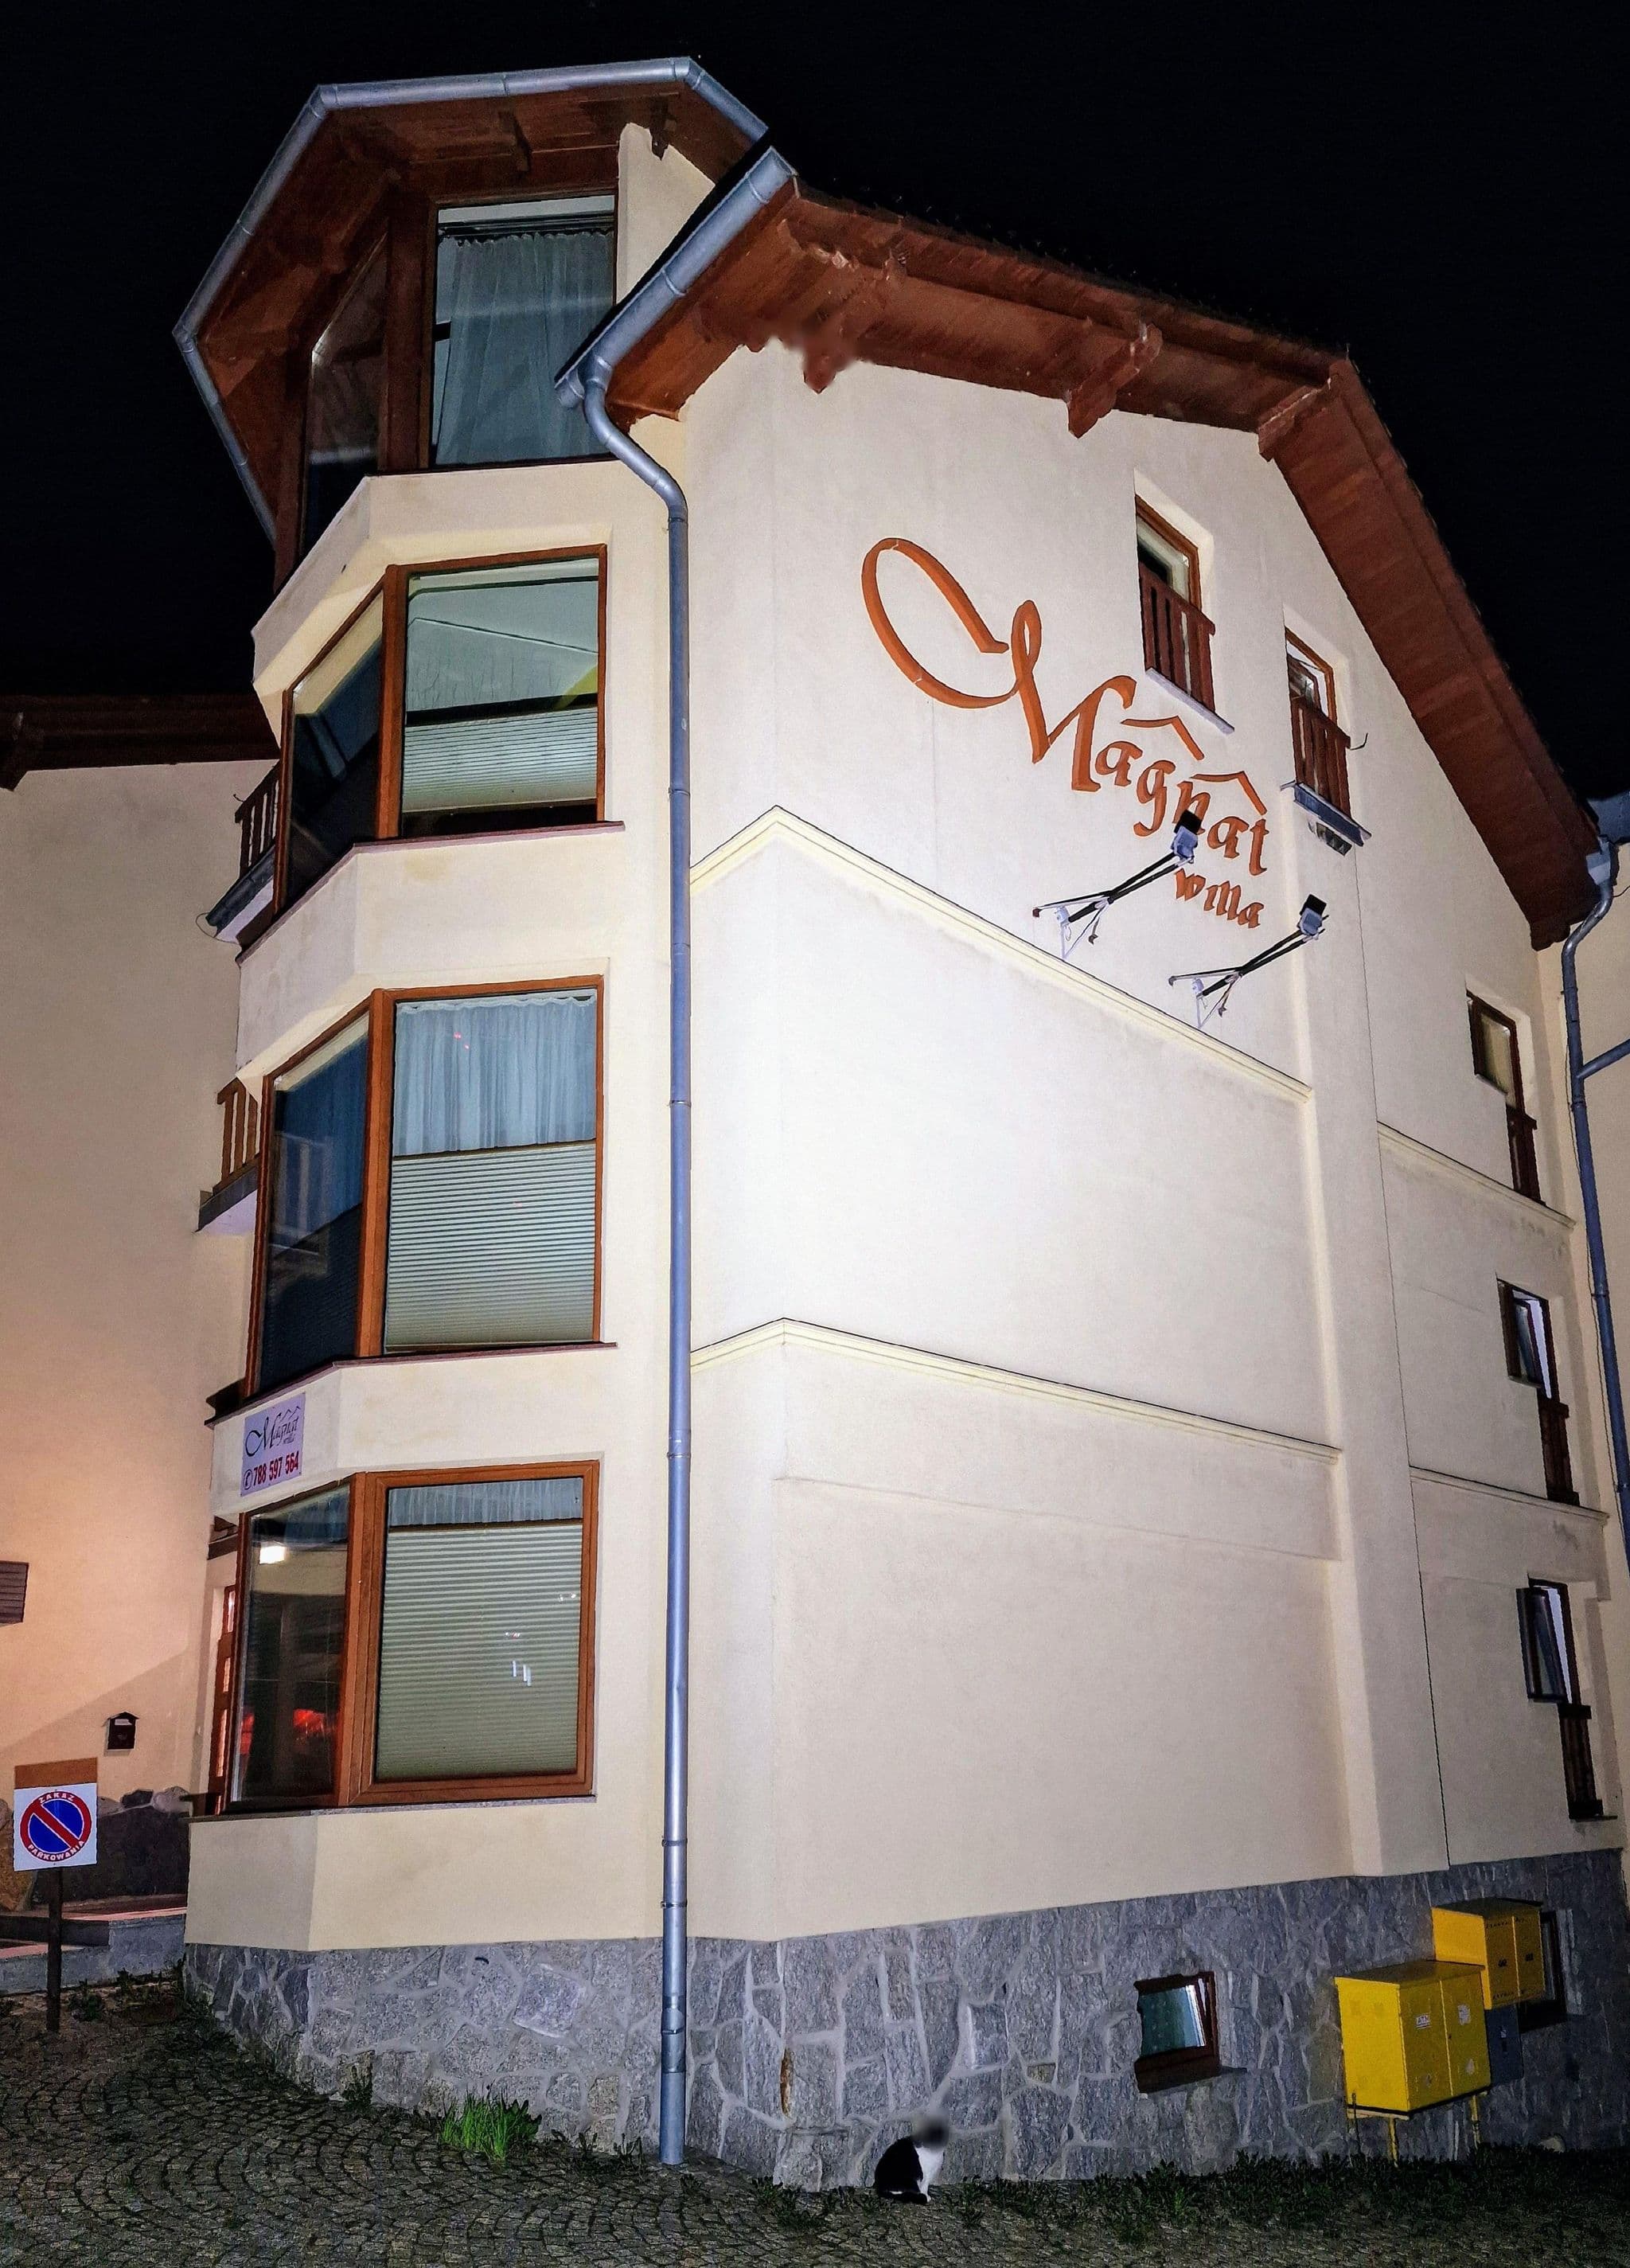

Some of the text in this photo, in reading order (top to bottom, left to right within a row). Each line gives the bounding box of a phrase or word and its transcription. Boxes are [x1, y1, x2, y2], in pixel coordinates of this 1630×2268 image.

[861, 537, 1269, 876] Magnat
[1174, 868, 1265, 929] willa
[253, 1450, 300, 1486] 788 597 564
[38, 1792, 75, 1804] ZAKAZ
[28, 1841, 85, 1861] PARKOWANIA
